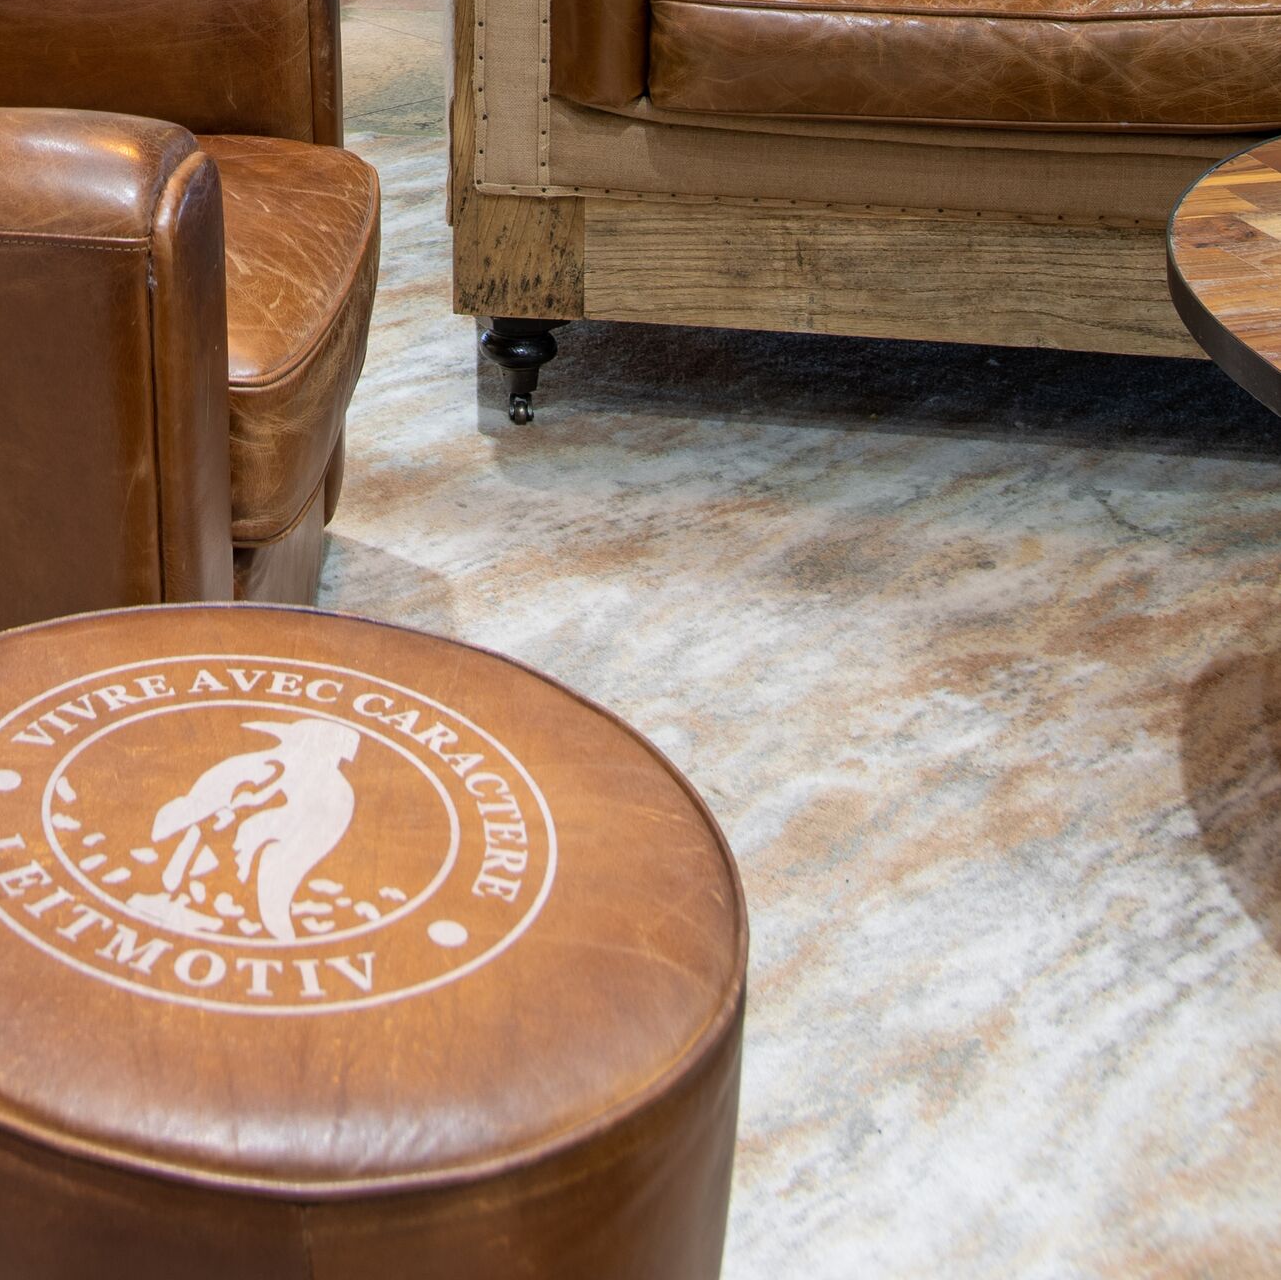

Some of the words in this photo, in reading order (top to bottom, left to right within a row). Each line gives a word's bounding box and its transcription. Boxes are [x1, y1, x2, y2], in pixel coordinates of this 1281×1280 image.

[11, 673, 176, 749] VIVRE
[187, 669, 344, 703] AVEC
[353, 692, 529, 904] CARACTERE
